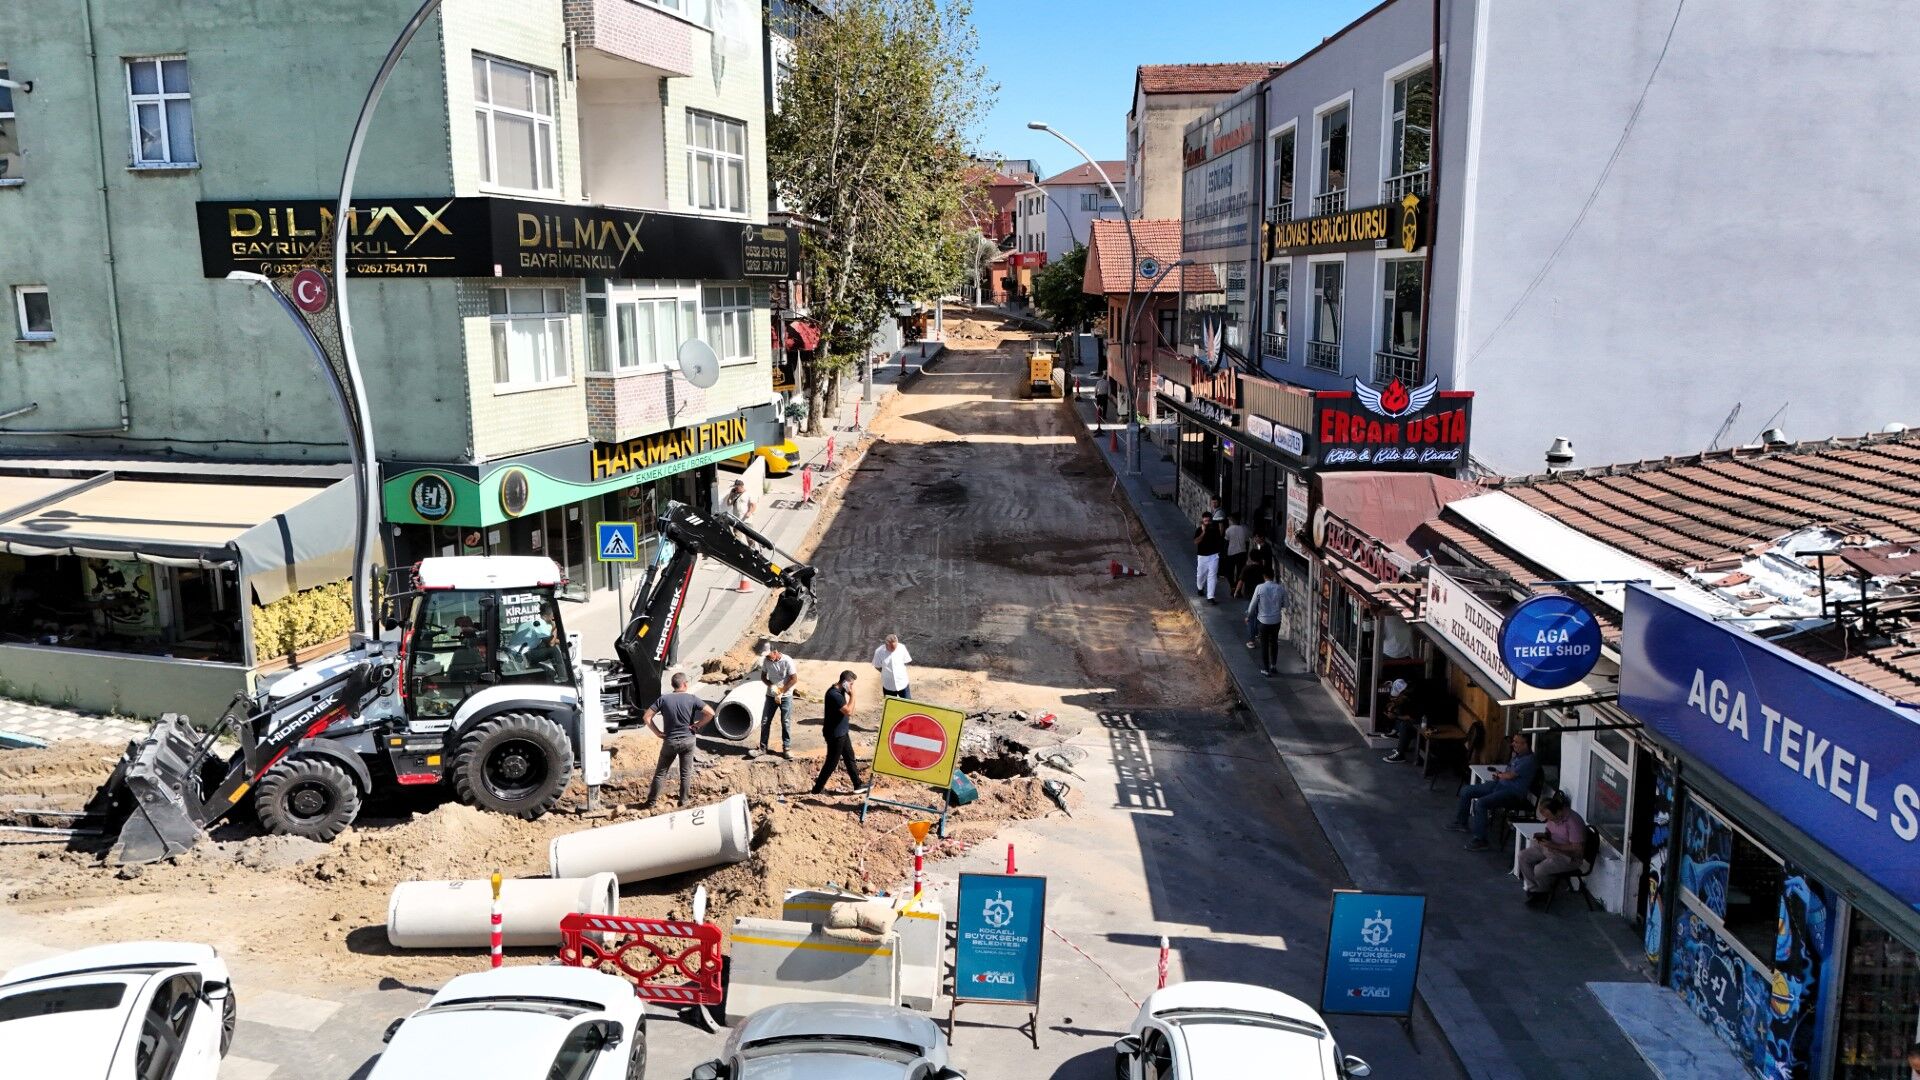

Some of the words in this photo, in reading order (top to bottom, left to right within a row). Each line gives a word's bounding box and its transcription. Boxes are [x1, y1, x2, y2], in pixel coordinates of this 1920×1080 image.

[1311, 215, 1349, 245] SÜRÜCÜ
[1351, 208, 1387, 241] KURSU
[232, 237, 397, 255] GAYRİMEKUL
[358, 264, 383, 273] 0262
[385, 264, 404, 273] 754
[406, 264, 415, 273] 71
[418, 264, 427, 273] 71
[520, 249, 616, 270] GAYRİMENKUL
[1406, 408, 1466, 444] USTA
[593, 427, 695, 479] HARMAN
[700, 417, 747, 451] FIRIN
[1359, 449, 1370, 461] &
[1373, 449, 1400, 464] Kilo
[1402, 449, 1417, 461] ile
[1419, 449, 1461, 463] Kanat
[636, 468, 662, 483] EKMEK
[668, 463, 686, 476] CAFE
[1535, 629, 1569, 644] AGA
[1513, 646, 1552, 658] TEKEL
[1555, 644, 1591, 657] SHOP
[1687, 668, 1749, 741] AGA
[1760, 704, 1878, 822] TEKEL
